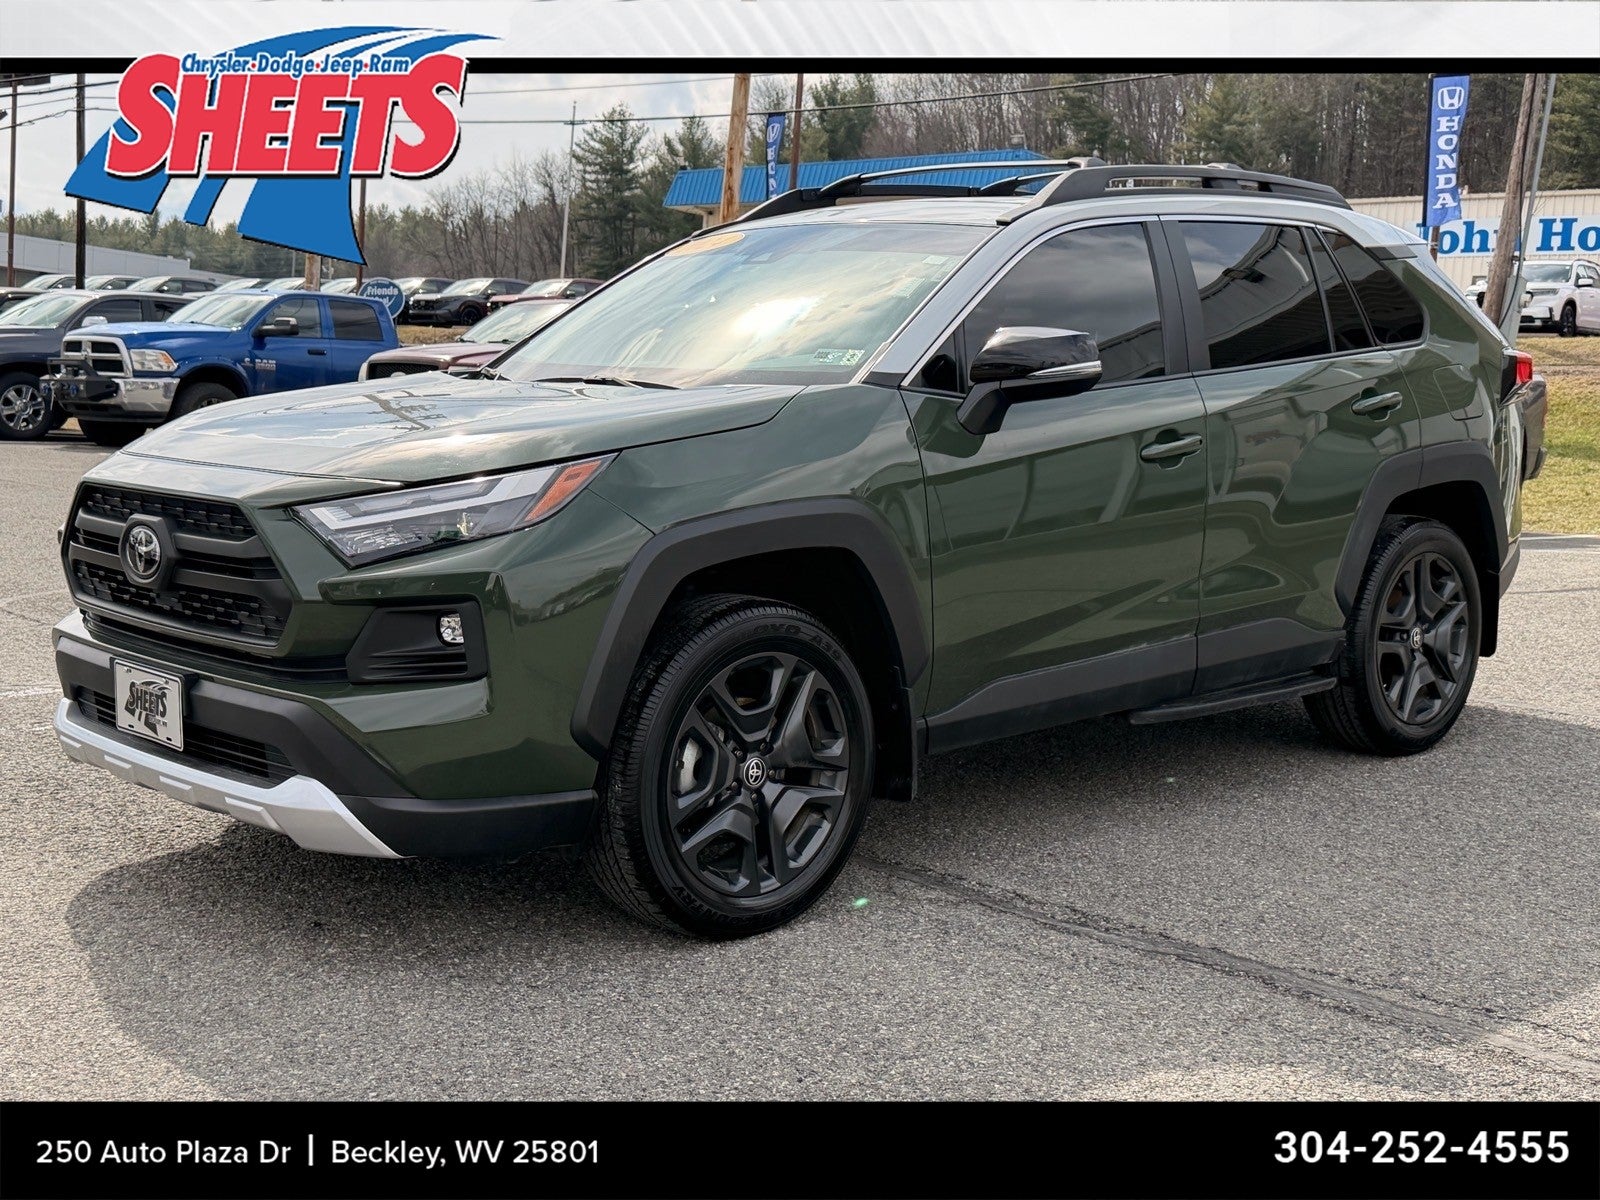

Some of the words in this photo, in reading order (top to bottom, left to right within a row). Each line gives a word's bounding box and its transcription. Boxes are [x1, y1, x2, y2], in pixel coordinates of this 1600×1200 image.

[1434, 116, 1458, 209] HONDA
[367, 285, 398, 296] Friends
[129, 681, 167, 718] SHEETS
